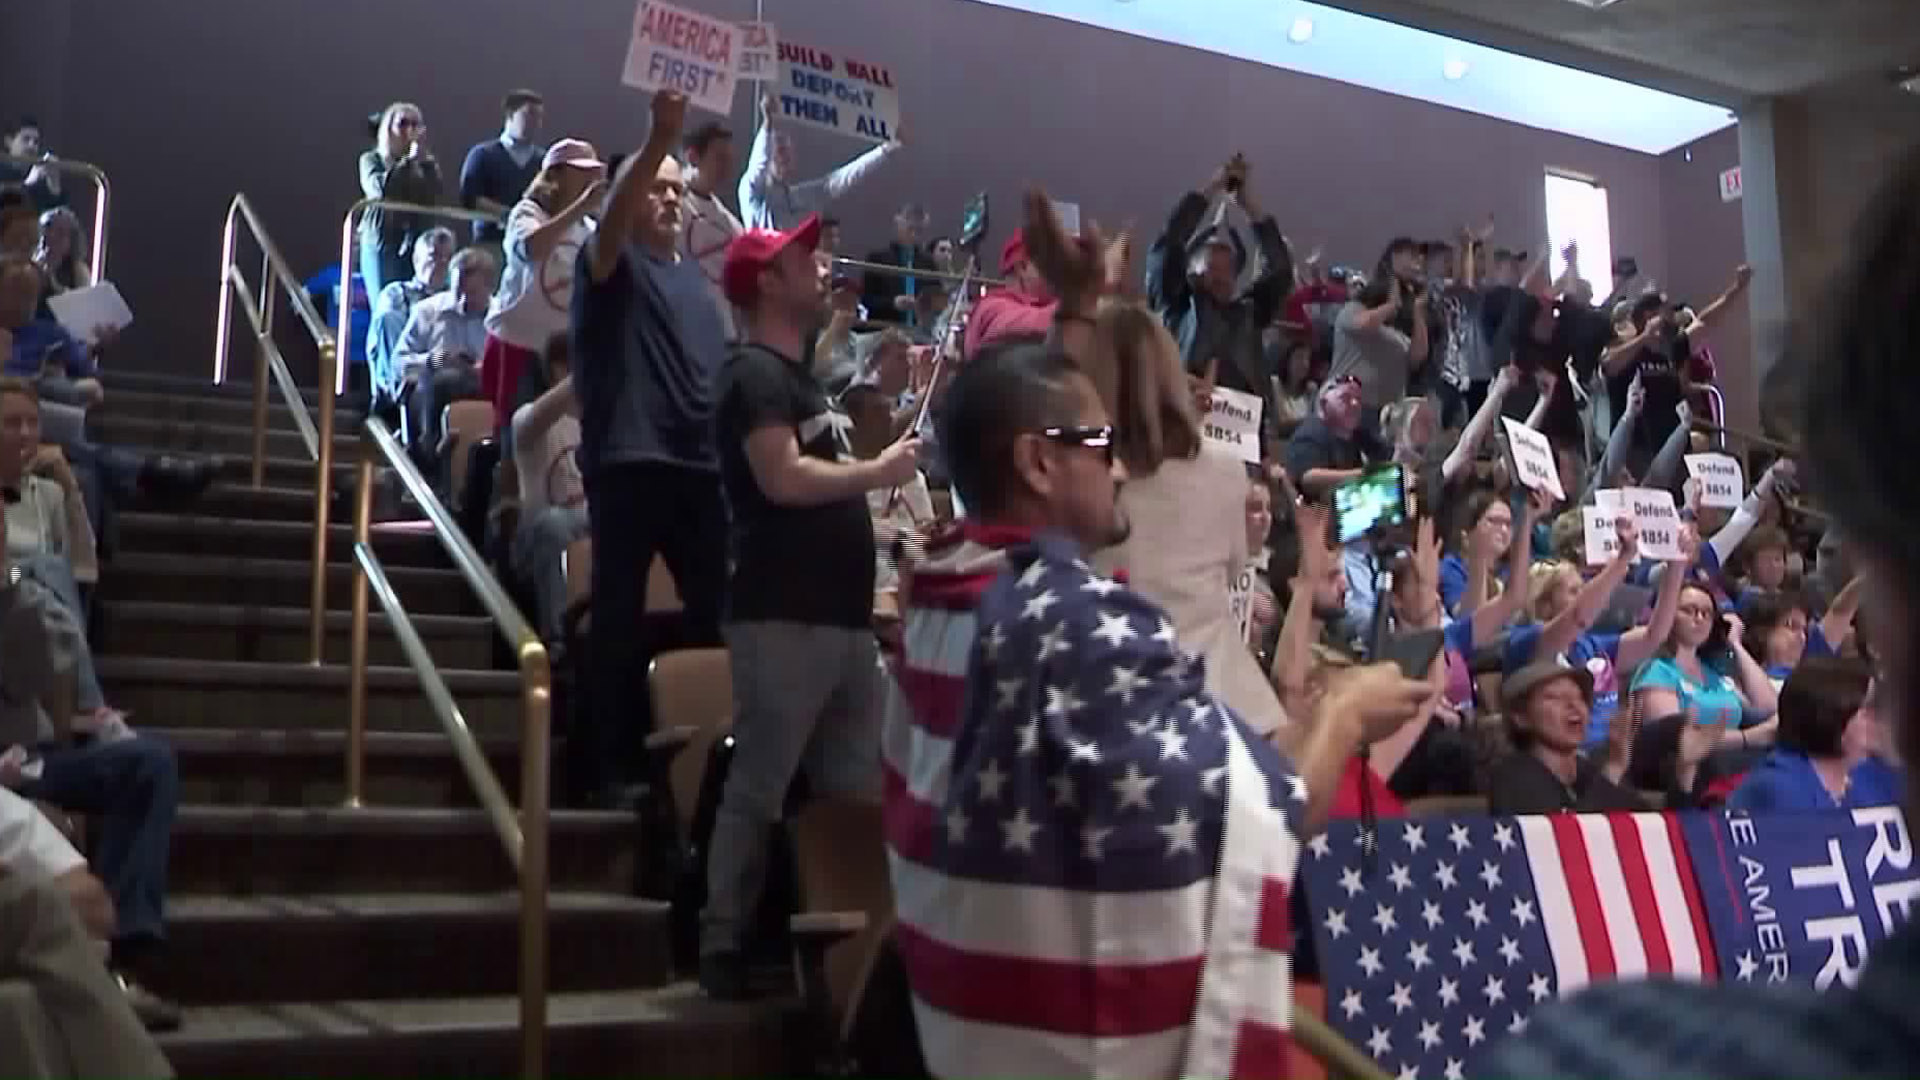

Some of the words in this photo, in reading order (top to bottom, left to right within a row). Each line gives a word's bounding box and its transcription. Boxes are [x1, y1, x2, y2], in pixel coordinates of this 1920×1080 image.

[777, 41, 834, 72] BUILD
[845, 58, 893, 88] WALL
[856, 113, 890, 140] ALL
[1210, 400, 1252, 421] efend
[1697, 462, 1736, 476] Defend
[1633, 500, 1674, 518] Defend
[1726, 810, 1757, 847] E
[1851, 806, 1920, 938] RE
[1739, 856, 1789, 985] AMER
[1791, 838, 1869, 992] TR
